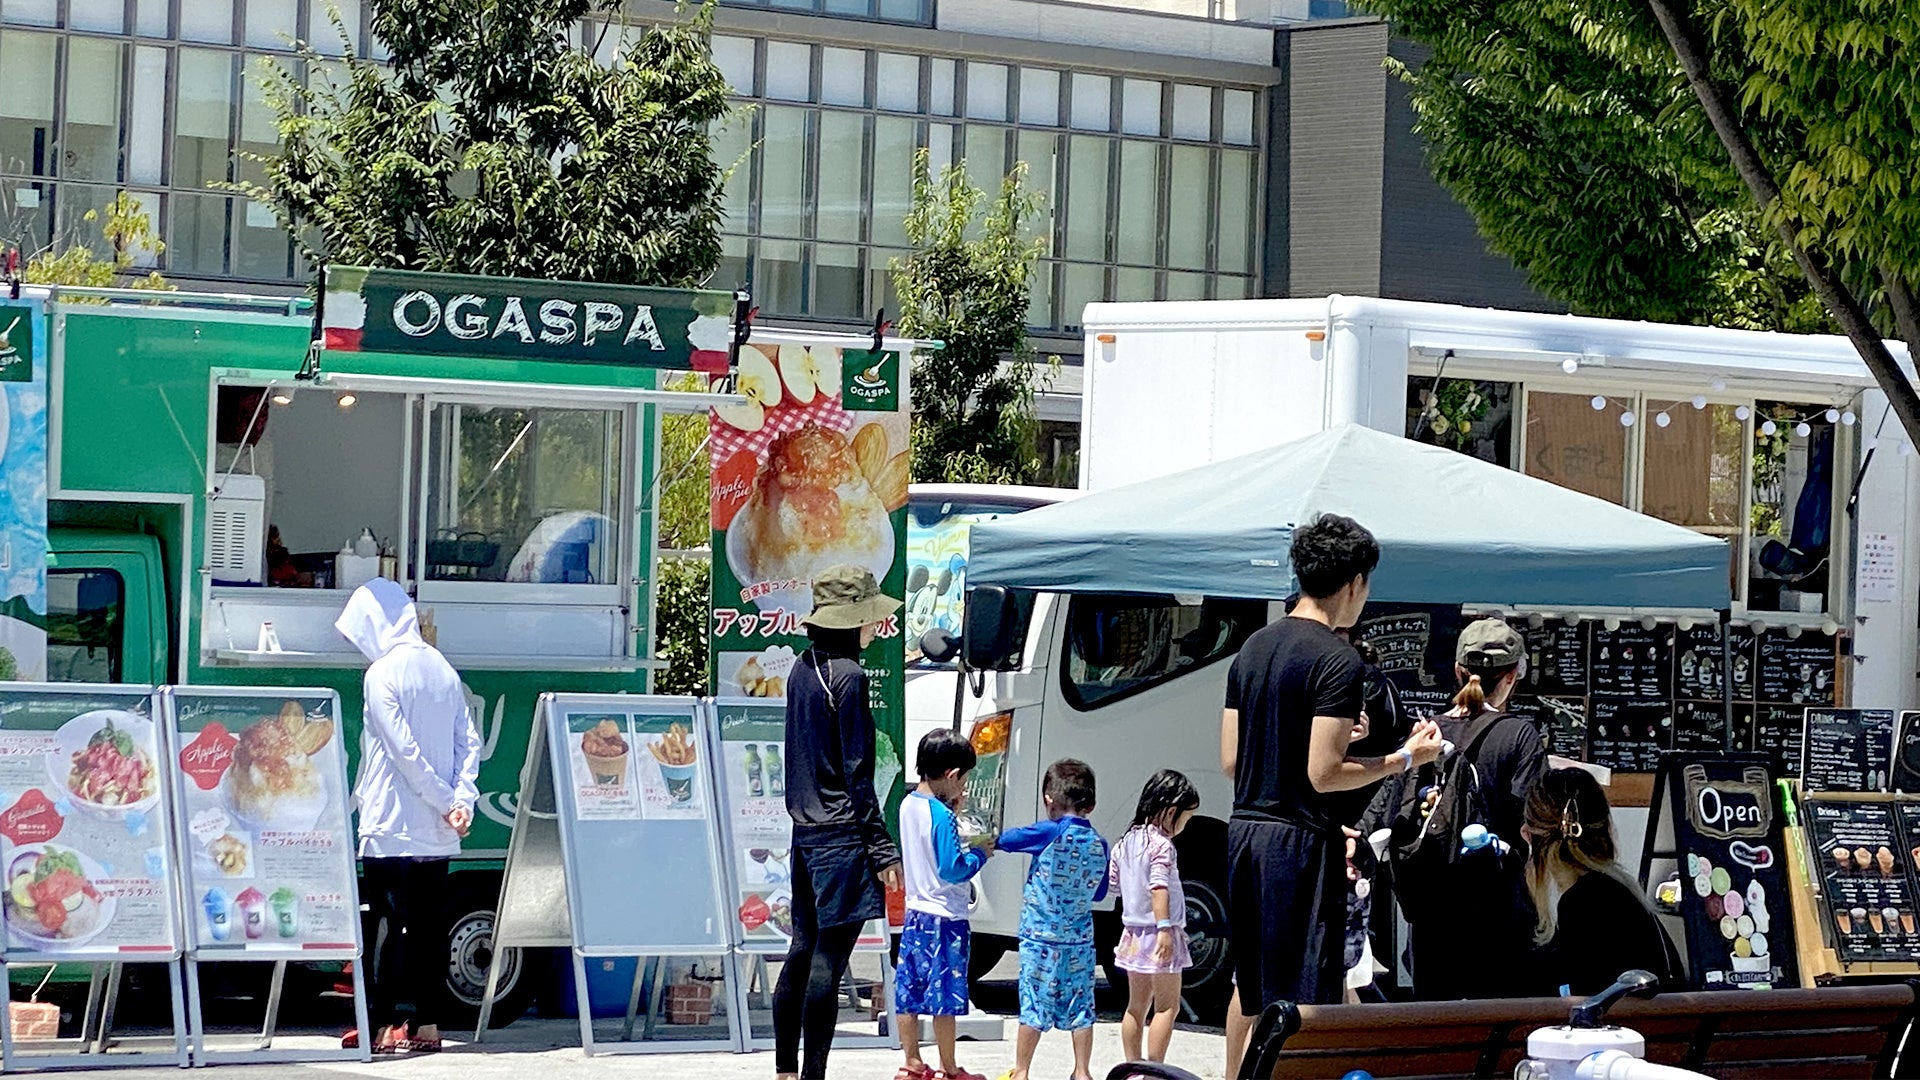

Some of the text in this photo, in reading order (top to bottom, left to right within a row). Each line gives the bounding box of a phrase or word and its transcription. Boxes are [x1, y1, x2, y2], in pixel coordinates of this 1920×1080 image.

[392, 289, 666, 351] OGASPA
[850, 387, 891, 398] OGASPA
[186, 738, 223, 764] Apple
[1698, 787, 1761, 833] Open
